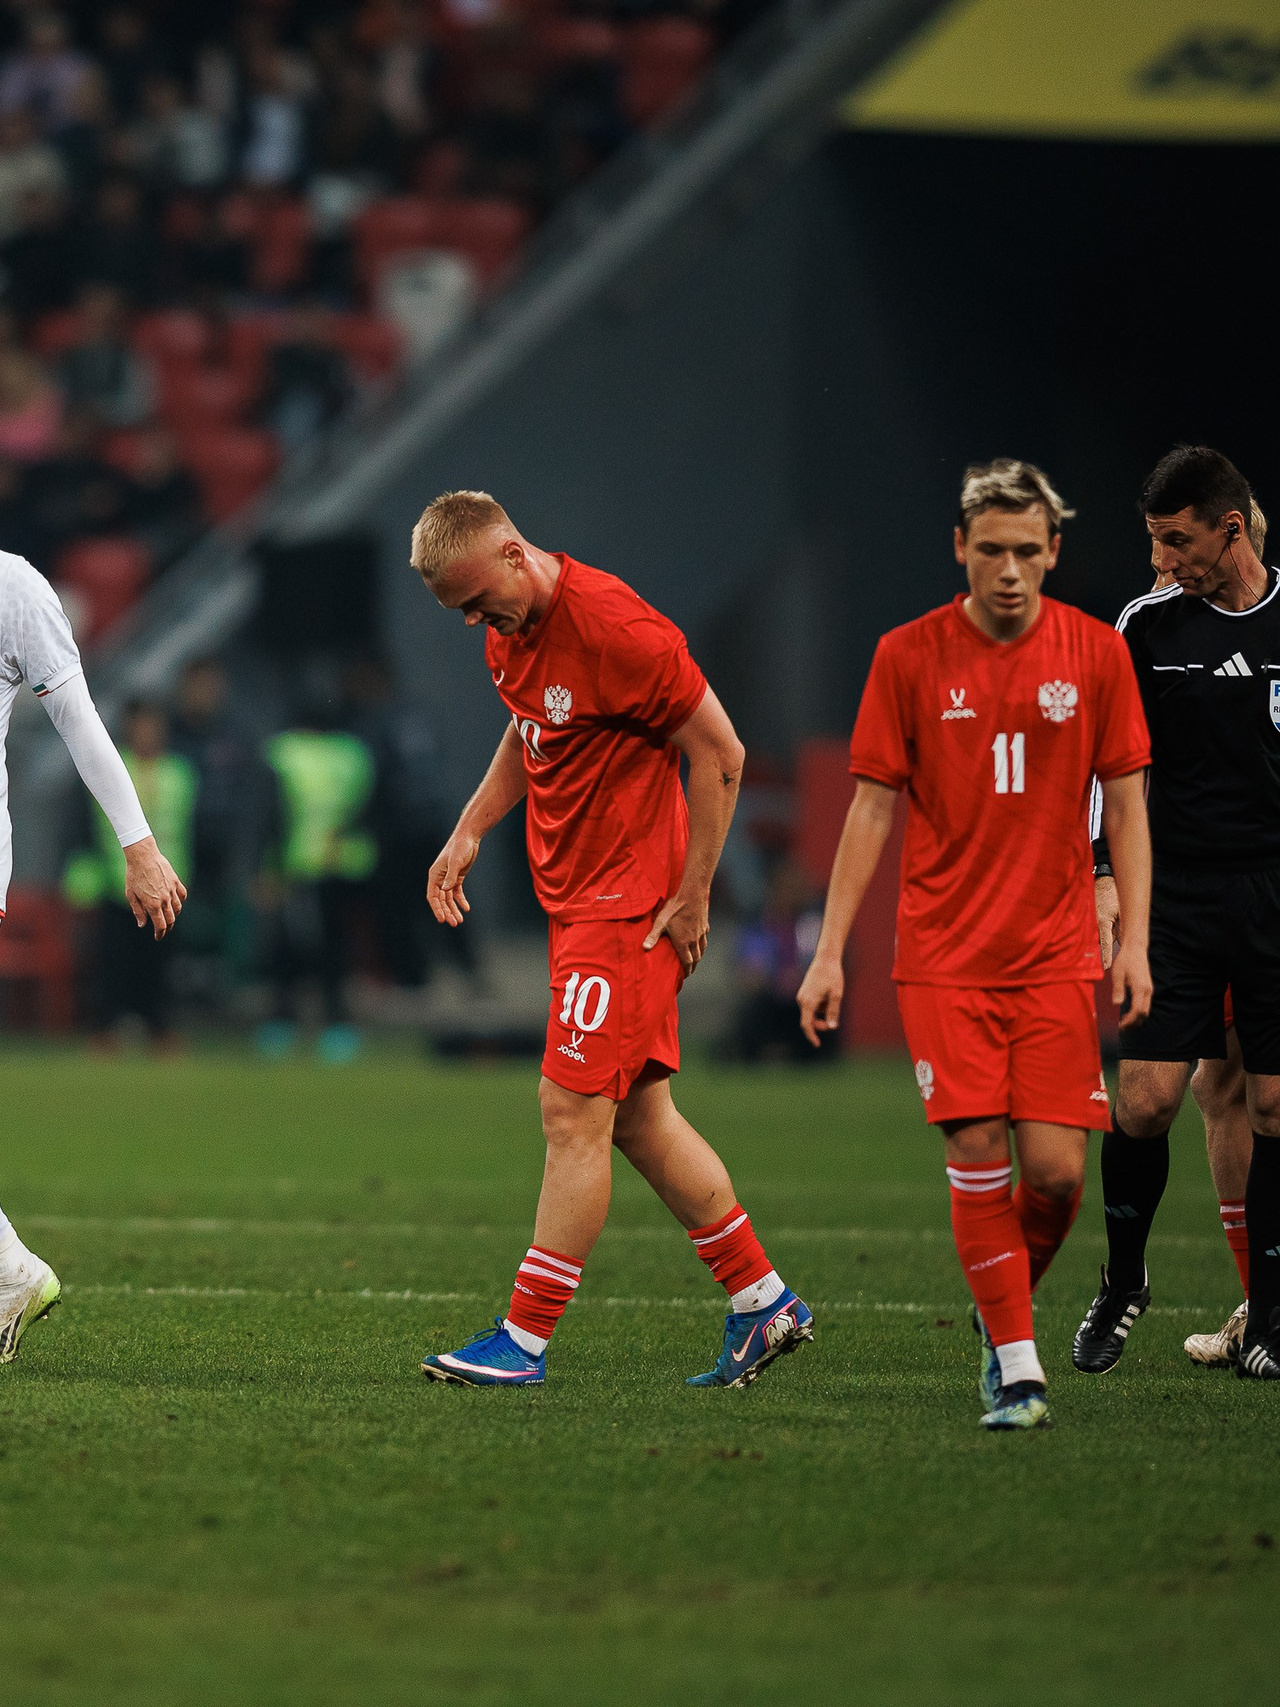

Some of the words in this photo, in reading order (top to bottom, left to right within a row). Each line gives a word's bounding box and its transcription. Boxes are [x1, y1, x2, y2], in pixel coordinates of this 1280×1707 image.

[990, 732, 1025, 794] 11
[559, 971, 612, 1032] 10
[557, 1044, 587, 1064] JOGEL
